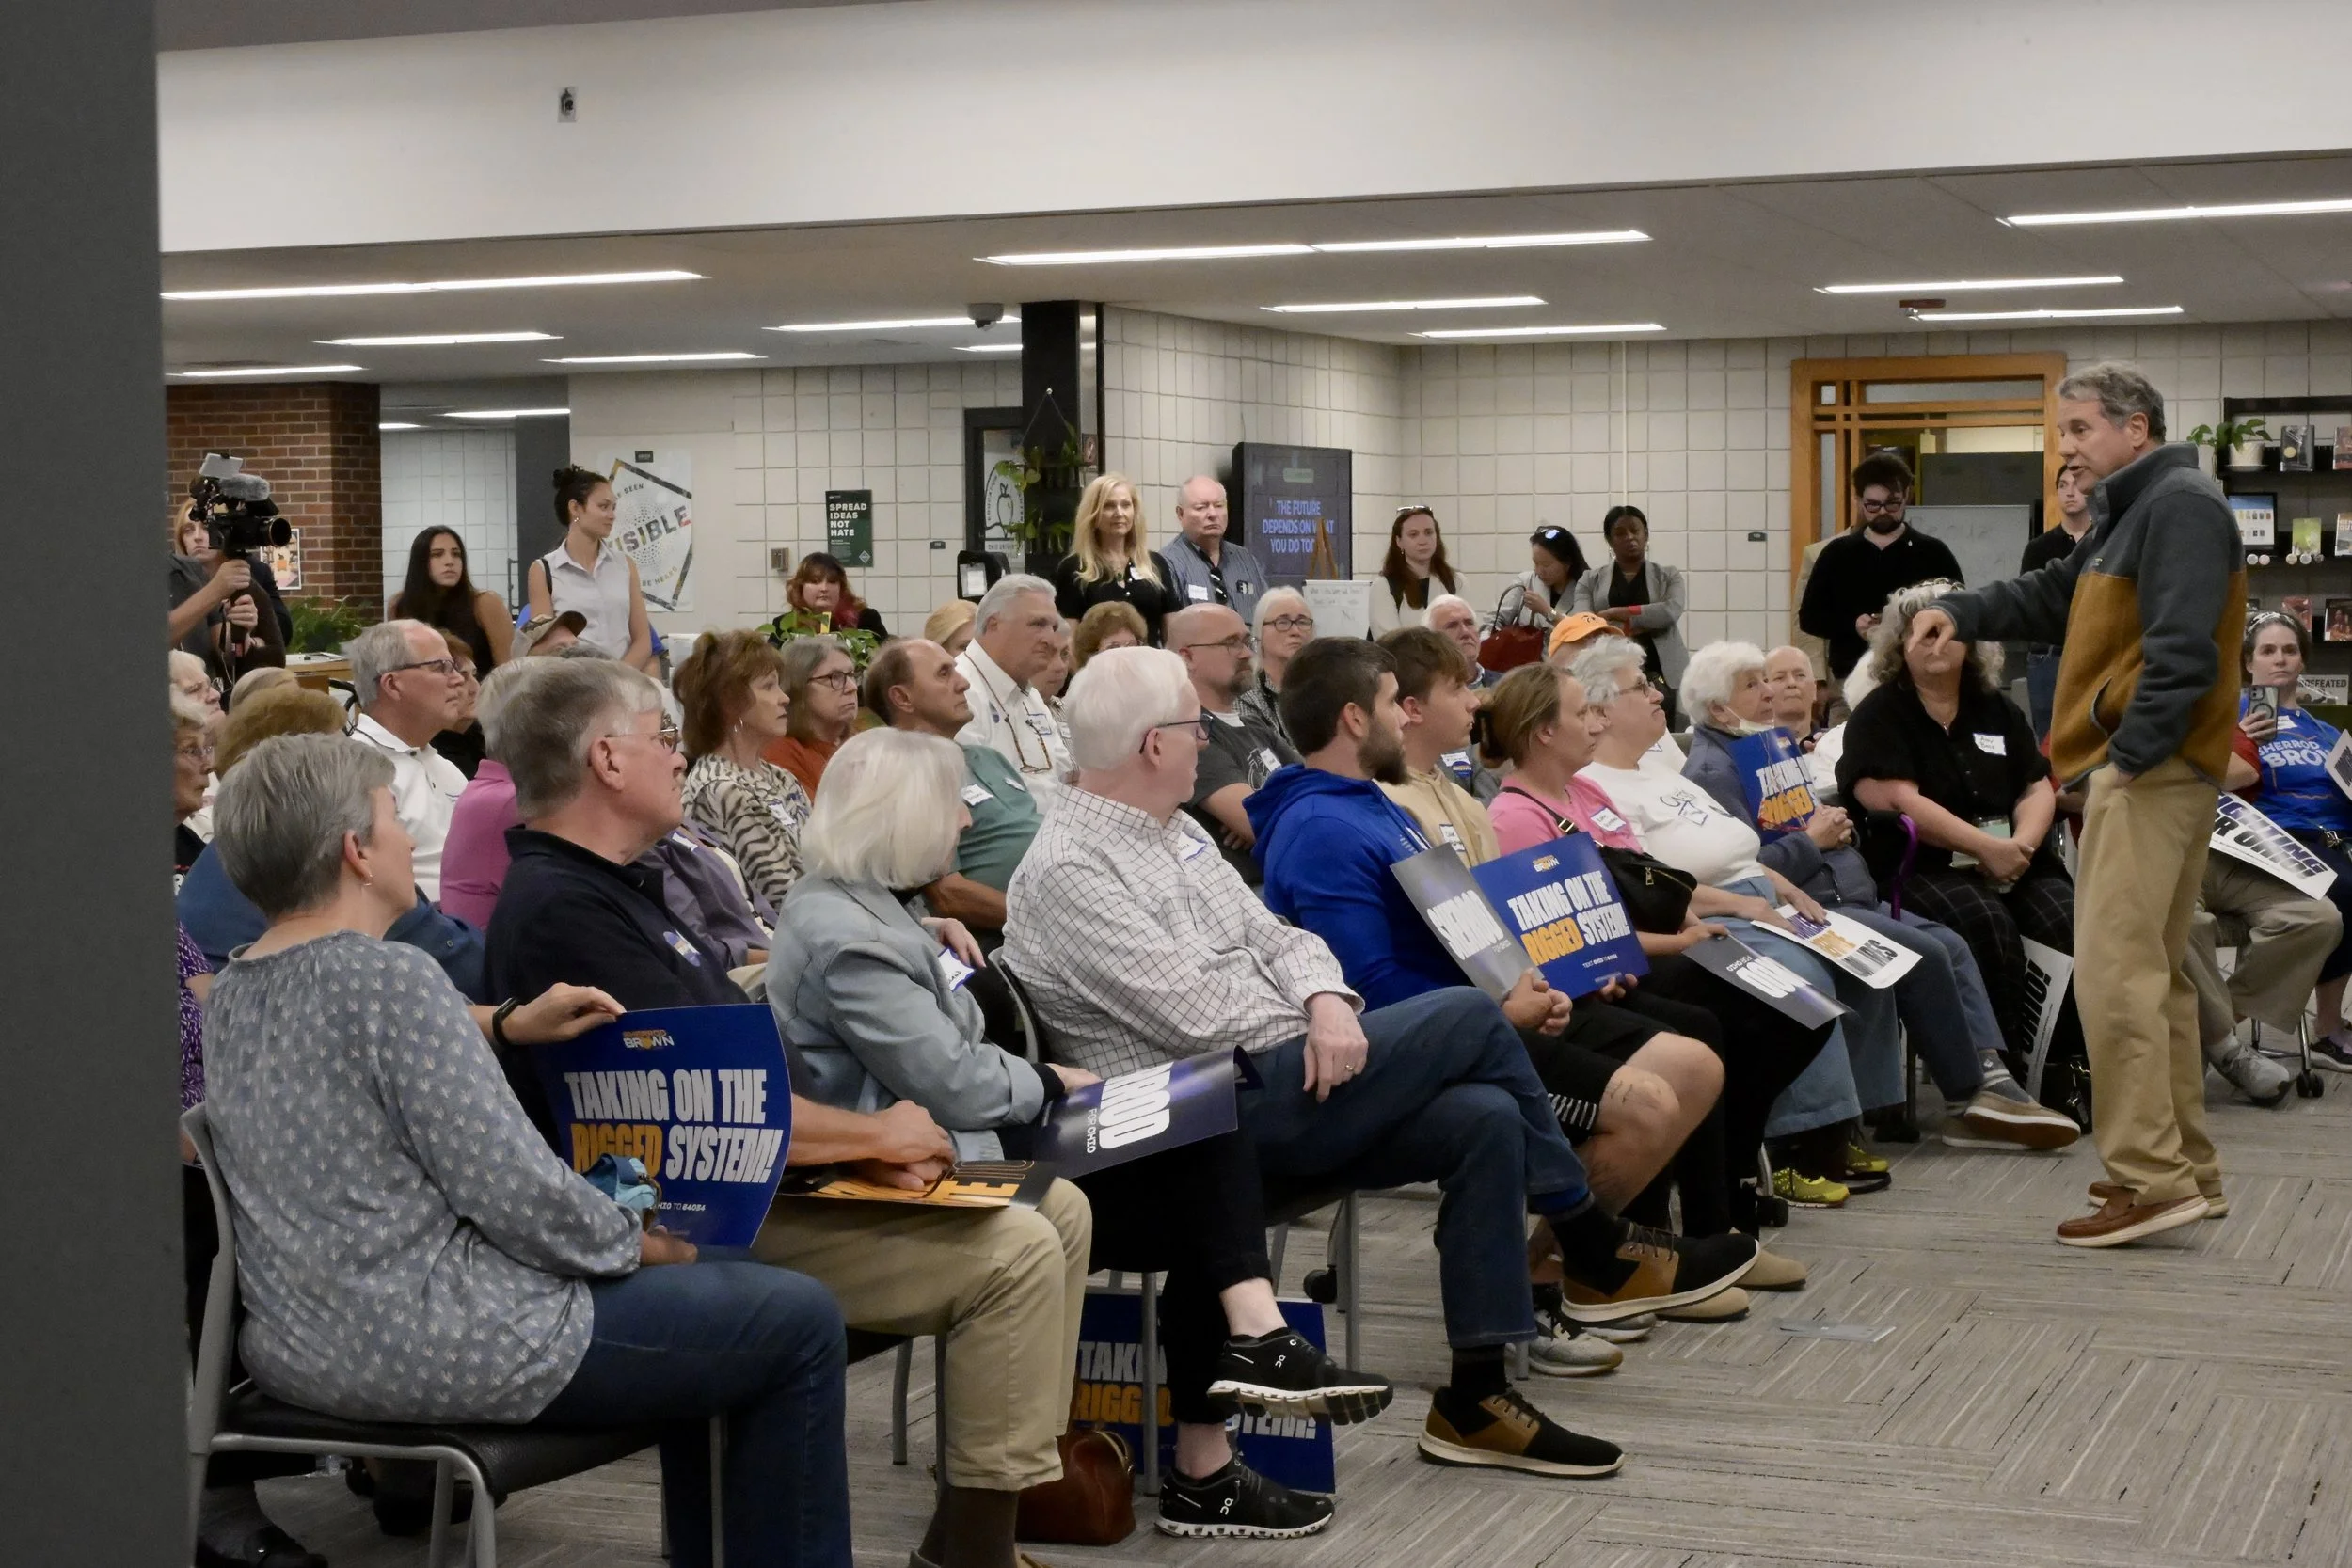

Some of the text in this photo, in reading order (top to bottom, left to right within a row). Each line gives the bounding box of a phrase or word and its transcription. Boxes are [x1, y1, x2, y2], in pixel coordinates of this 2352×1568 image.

[624, 483, 644, 495] SEEN
[1277, 500, 1321, 515] THE FUTURE
[608, 505, 692, 553] ISIBLE
[1263, 519, 1298, 534] DEPENDS
[1299, 519, 1311, 534] ON
[1270, 538, 1287, 553] YOU
[1288, 538, 1300, 553] DO
[1756, 758, 1806, 796] TAKING
[1506, 870, 1613, 931] TAKING ON THE
[1520, 917, 1584, 967] RIGGED
[564, 1069, 767, 1124] TAKING ON THE
[1087, 1108, 1098, 1154] FOR OHIO
[665, 1125, 784, 1183] SYSTEM!
[650, 1202, 672, 1211] HIO
